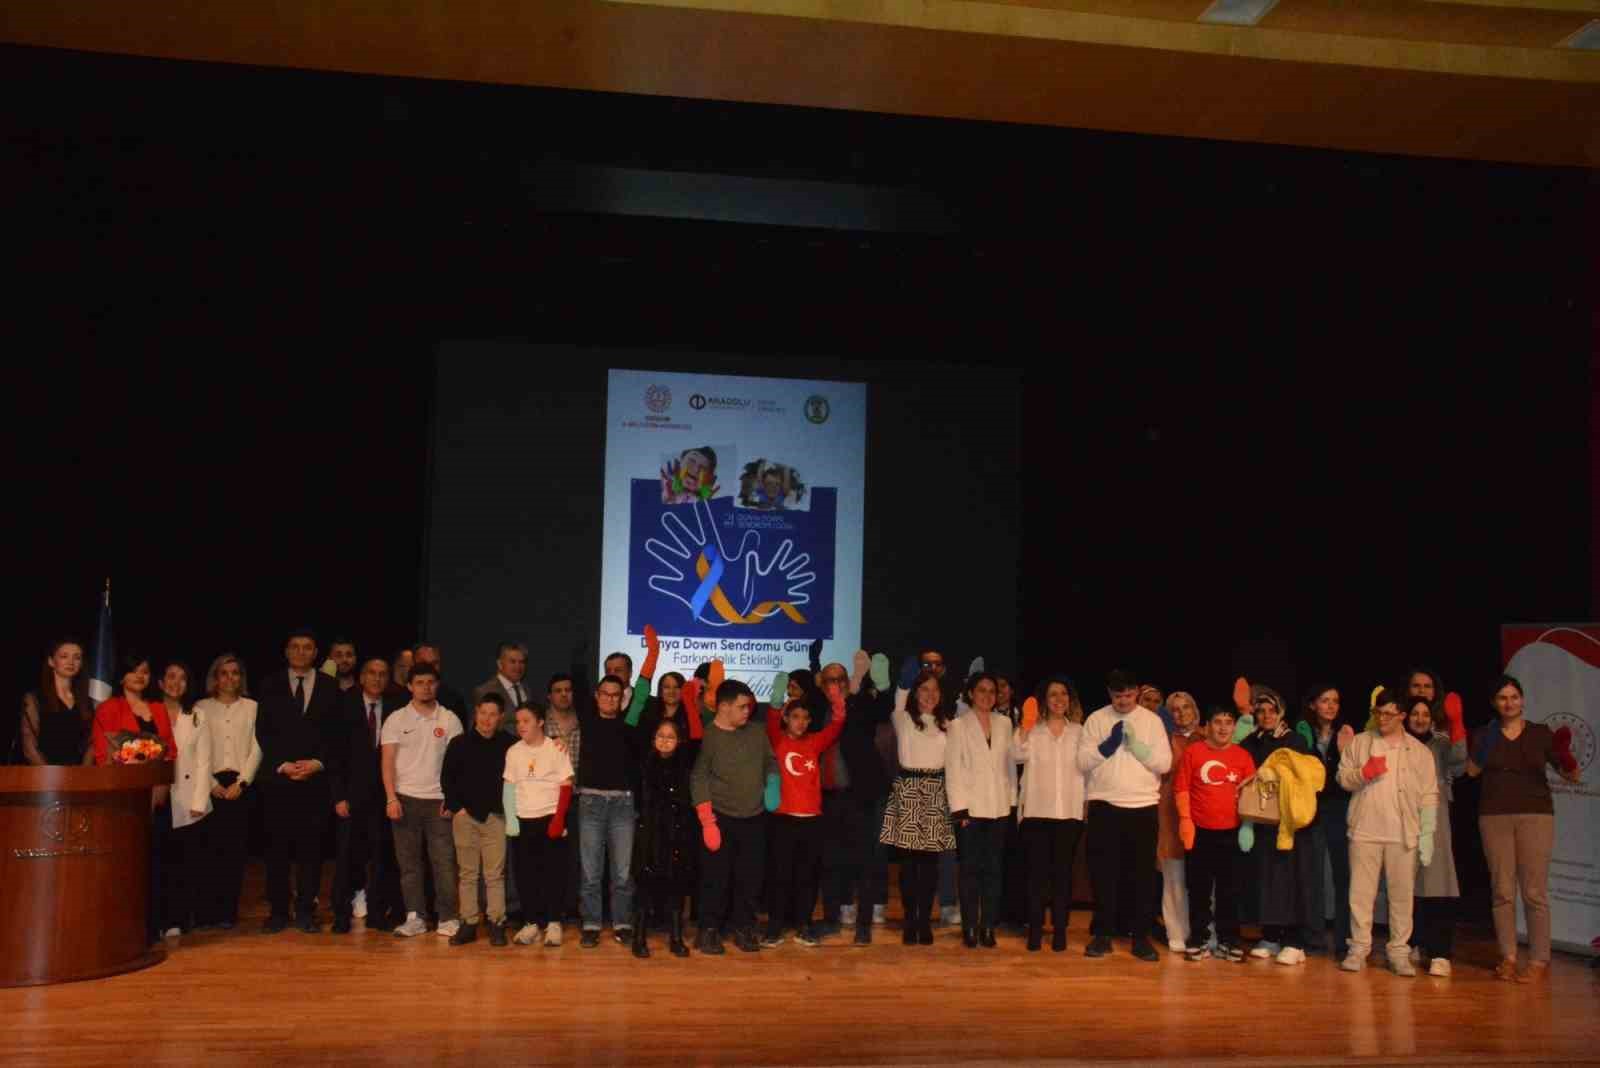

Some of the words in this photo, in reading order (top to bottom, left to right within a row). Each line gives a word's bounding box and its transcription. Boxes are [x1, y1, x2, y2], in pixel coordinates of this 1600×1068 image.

[641, 636, 680, 651] Dnya
[683, 638, 717, 650] Down
[720, 640, 781, 652] Sendromu
[783, 641, 810, 653] Gün
[739, 654, 783, 668] Etkinliği
